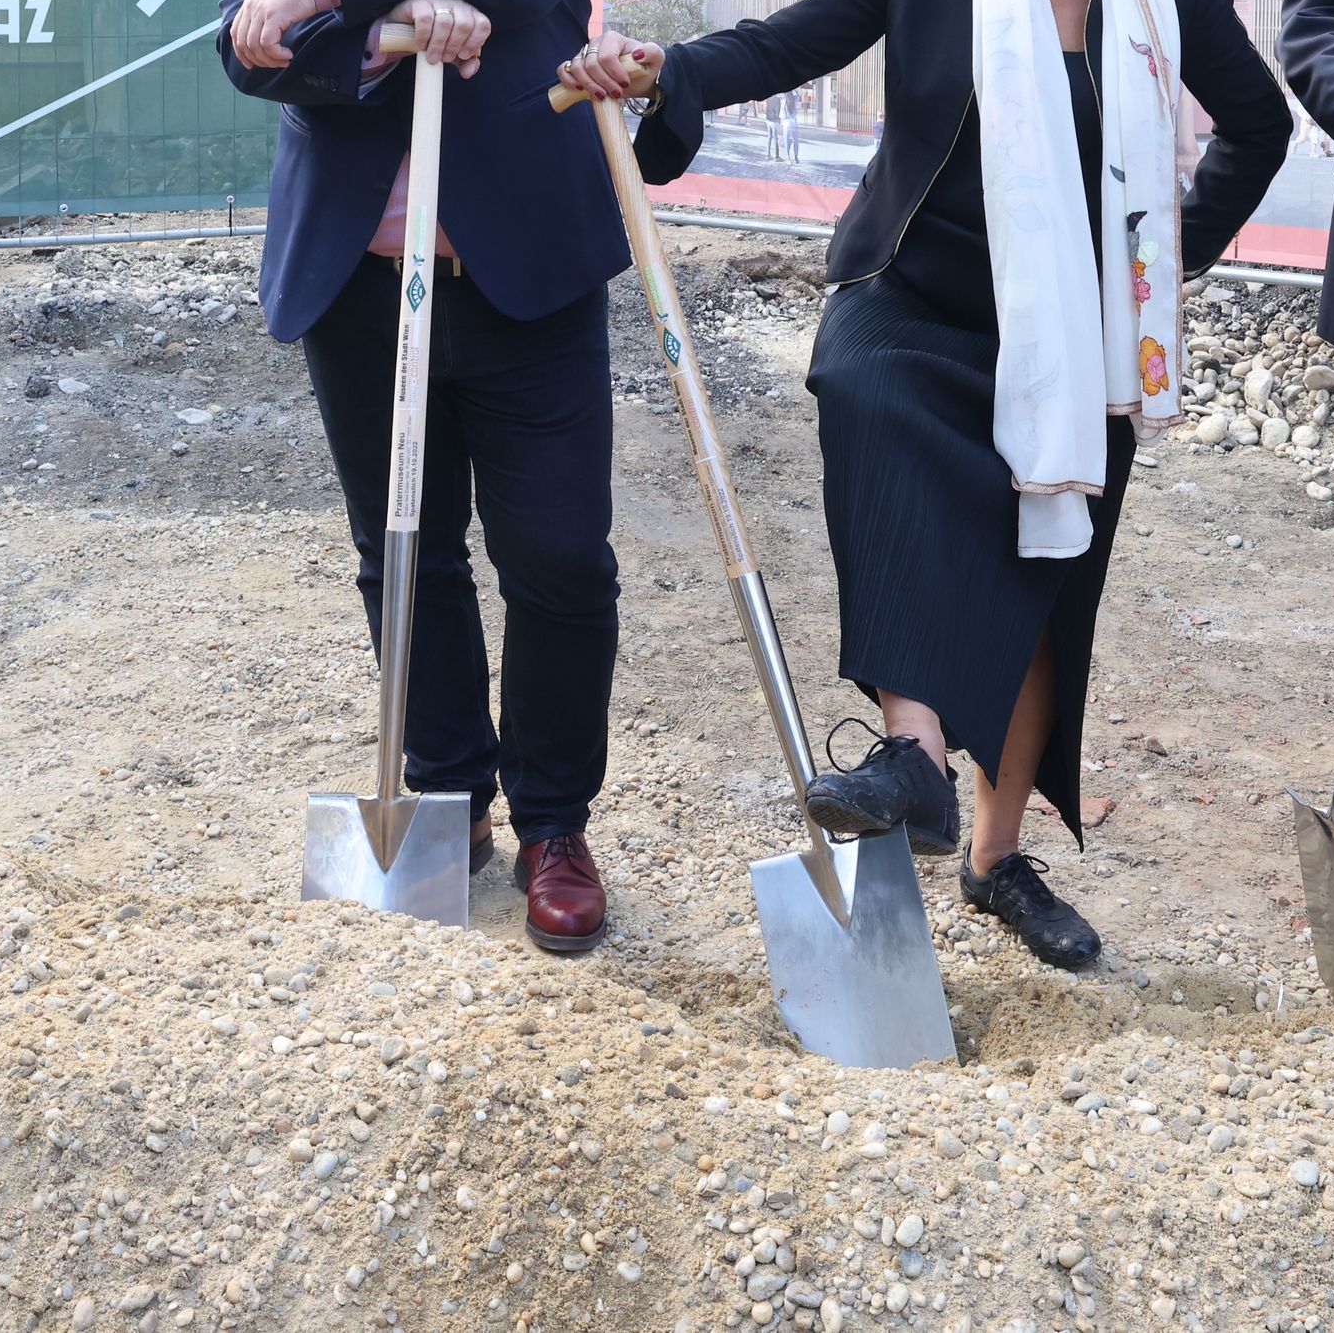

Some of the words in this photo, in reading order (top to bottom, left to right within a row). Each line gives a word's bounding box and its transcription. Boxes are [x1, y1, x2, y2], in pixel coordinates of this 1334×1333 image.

[402, 324, 410, 342] Wien
[399, 375, 407, 402] Museen
[397, 432, 405, 450] Neu
[410, 441, 418, 476] 19.10.2022
[395, 452, 405, 517] Pratermuseum
[409, 477, 417, 517] Spatenstich
[703, 484, 712, 501] Neu
[709, 503, 731, 567] Pratermuseum
